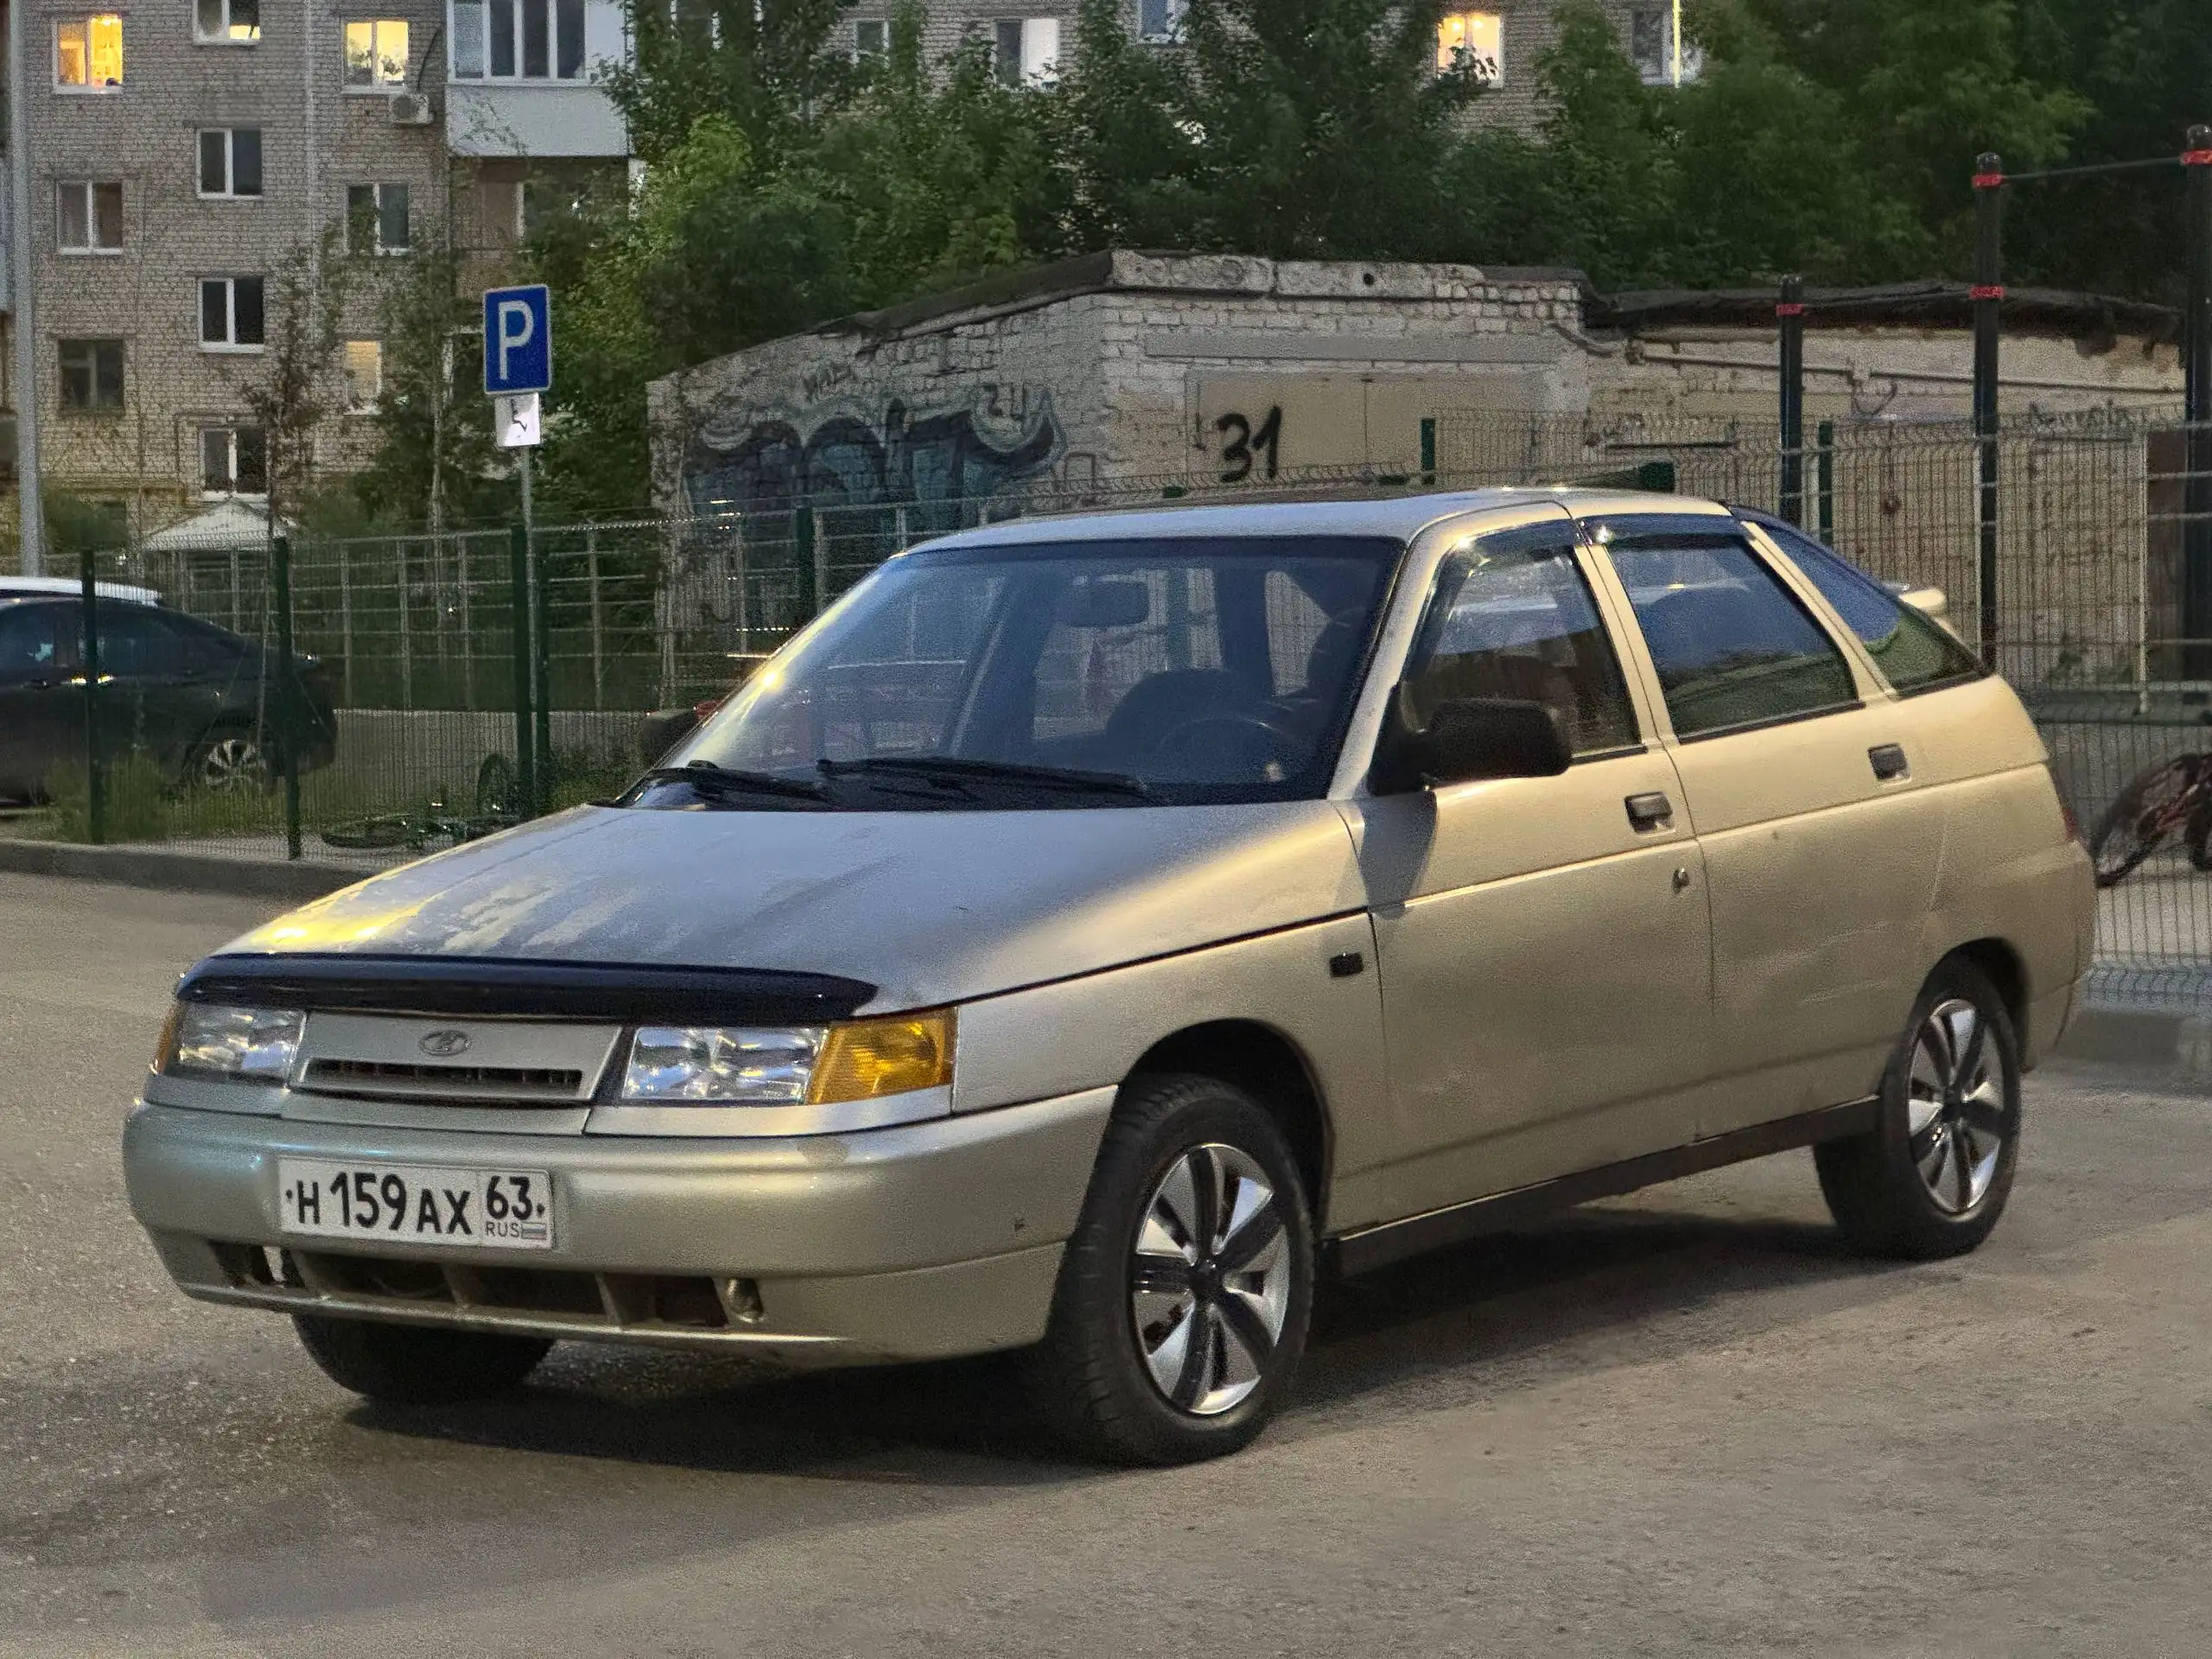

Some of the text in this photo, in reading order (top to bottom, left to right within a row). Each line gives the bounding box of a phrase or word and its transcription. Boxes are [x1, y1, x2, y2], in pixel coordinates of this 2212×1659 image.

[499, 301, 534, 380] P
[1215, 404, 1282, 483] 31
[486, 1175, 533, 1220] 63
[485, 1221, 521, 1237] RUS
